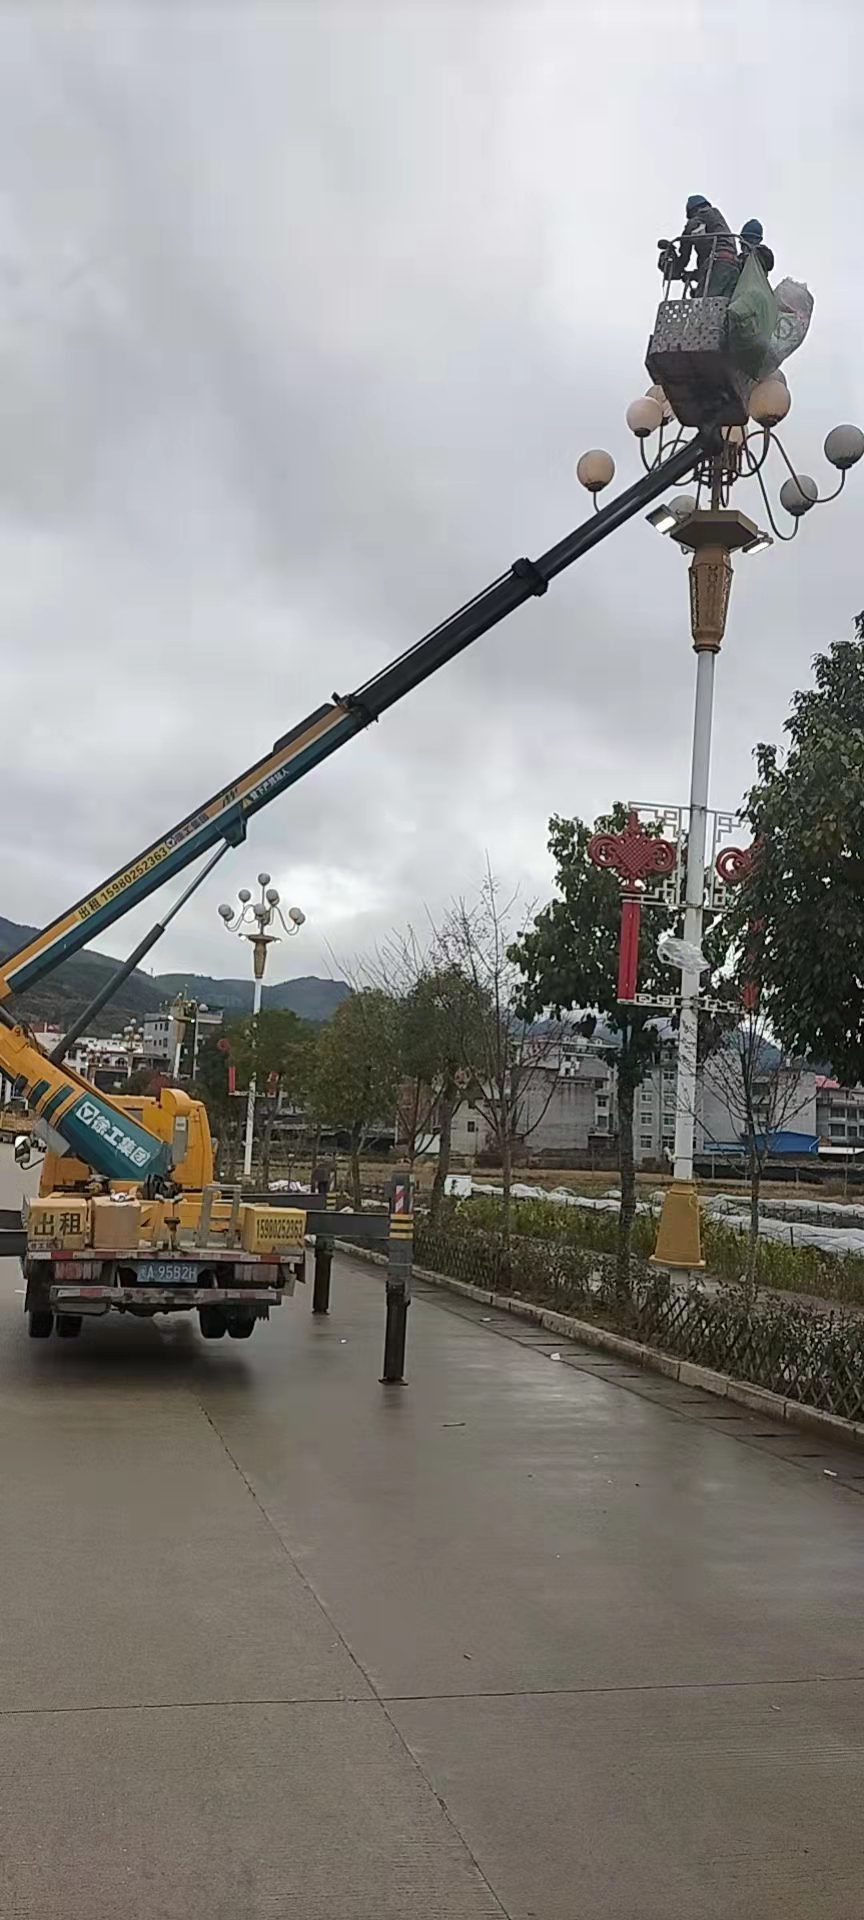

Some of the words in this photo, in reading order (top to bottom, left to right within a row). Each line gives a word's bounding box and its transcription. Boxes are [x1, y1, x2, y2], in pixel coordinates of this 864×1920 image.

[78, 898, 102, 919] 出租
[100, 846, 168, 902] 15980252363
[91, 1115, 151, 1168] 徐工集团
[34, 1212, 82, 1236] 出租
